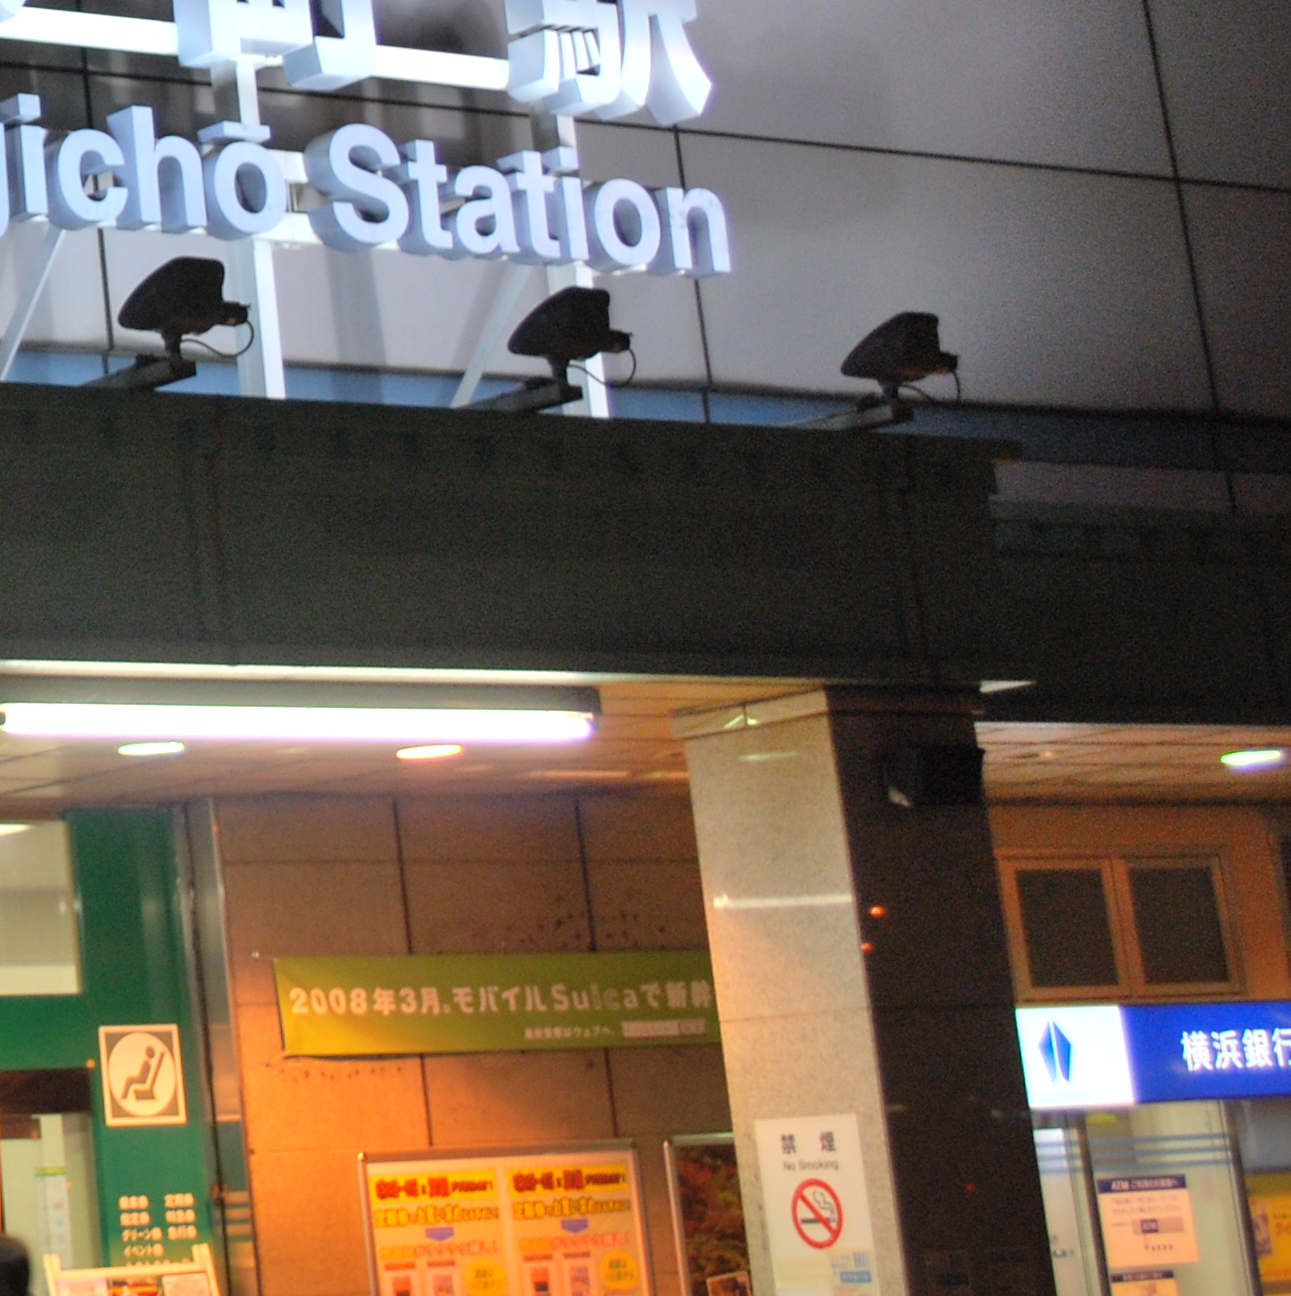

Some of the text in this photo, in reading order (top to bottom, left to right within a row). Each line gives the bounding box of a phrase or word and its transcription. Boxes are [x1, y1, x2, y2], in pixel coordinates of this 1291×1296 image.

[303, 122, 732, 277] Station
[1180, 1027, 1291, 1071] 横浜銀行
